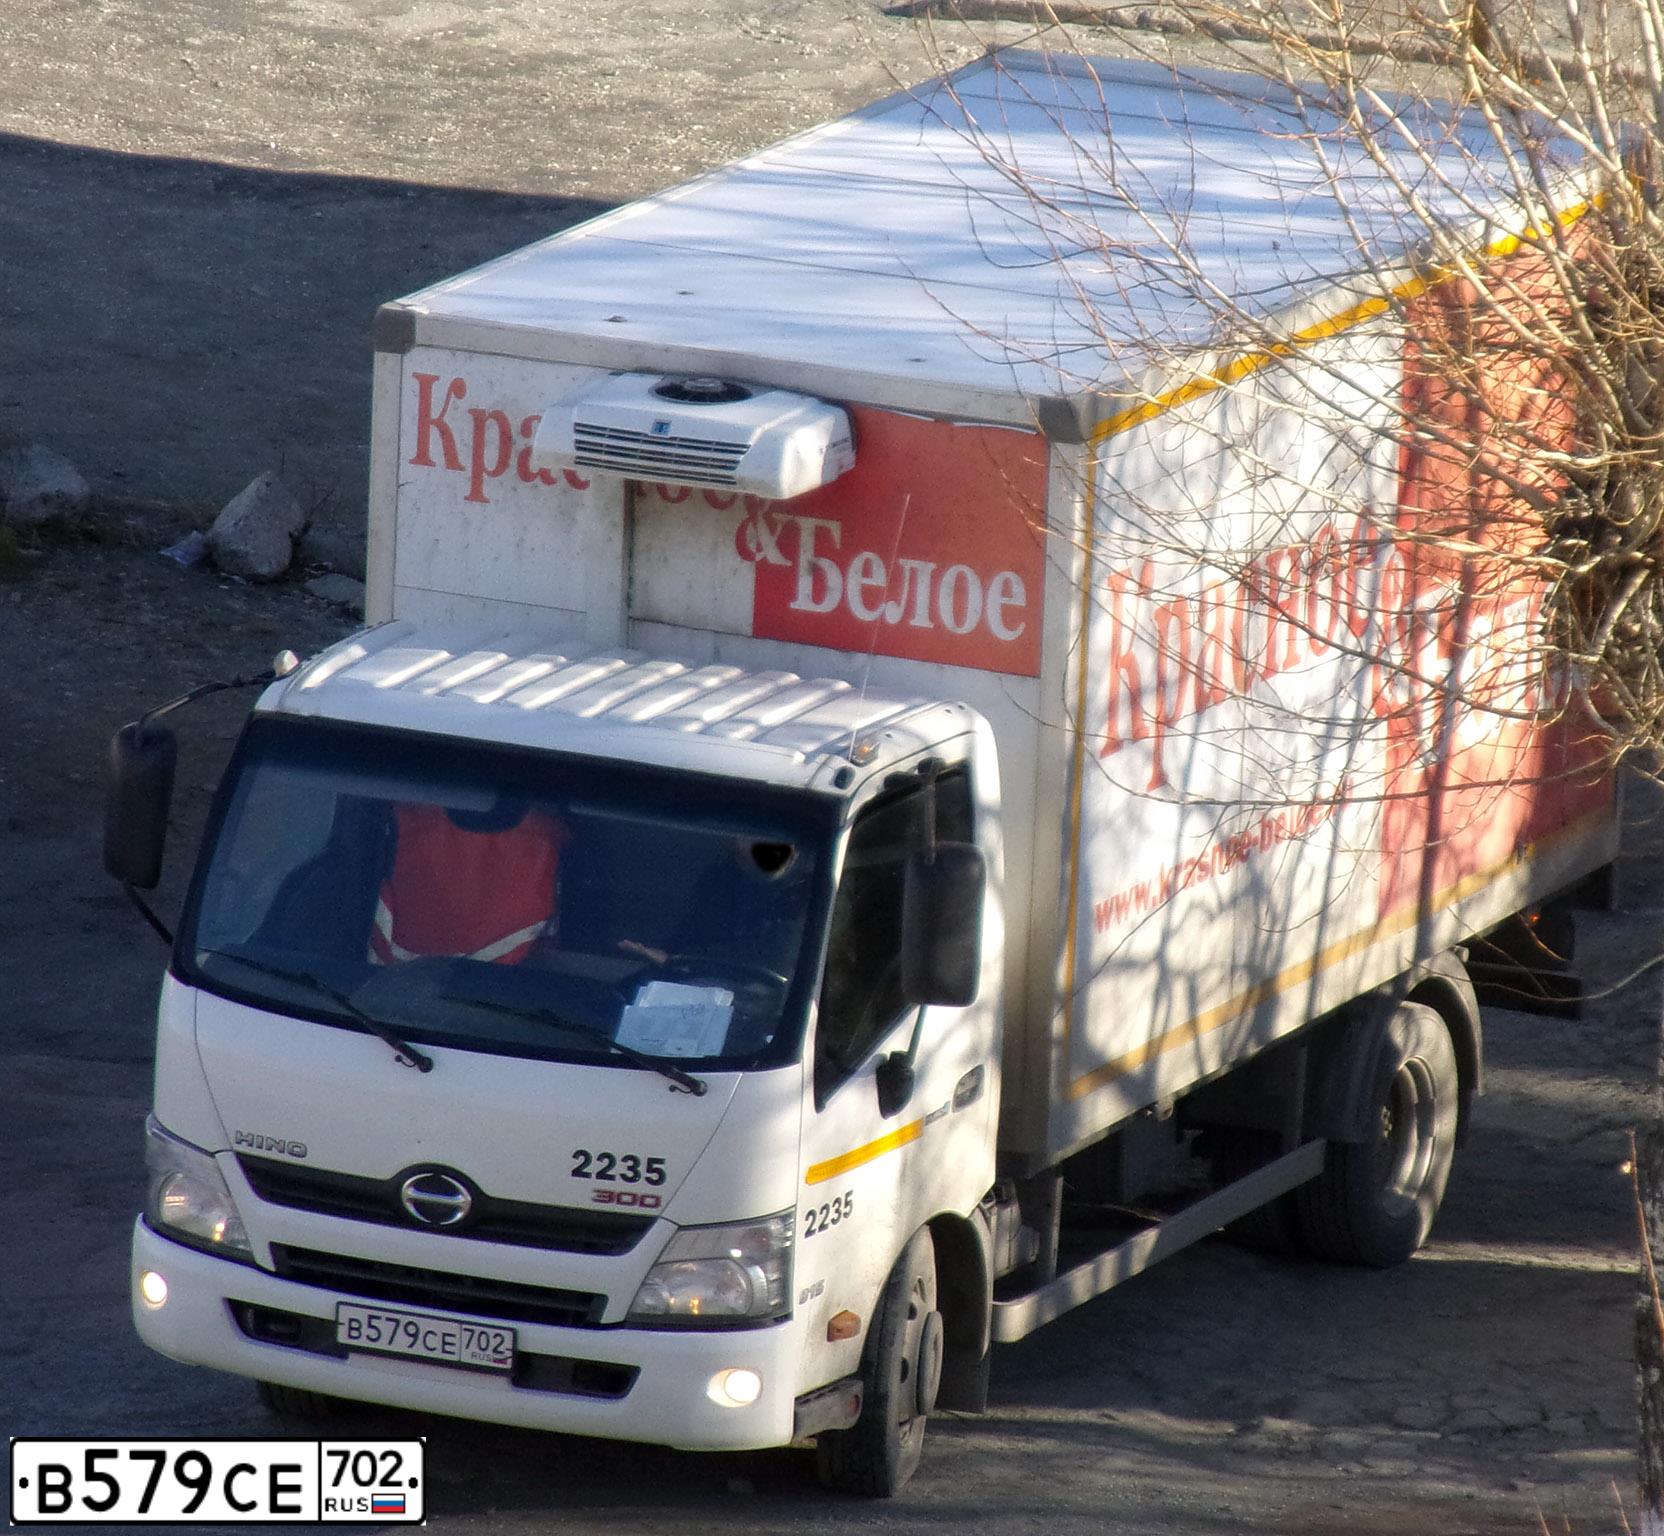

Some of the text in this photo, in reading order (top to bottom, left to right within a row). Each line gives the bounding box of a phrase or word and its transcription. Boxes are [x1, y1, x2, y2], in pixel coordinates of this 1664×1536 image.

[790, 514, 1027, 641] Белое
[235, 1130, 307, 1158] HINO
[571, 1149, 667, 1186] 2235
[591, 1188, 662, 1209] 300
[804, 1189, 854, 1239] 2235
[463, 1327, 506, 1356] 702
[471, 1351, 492, 1363] RUS
